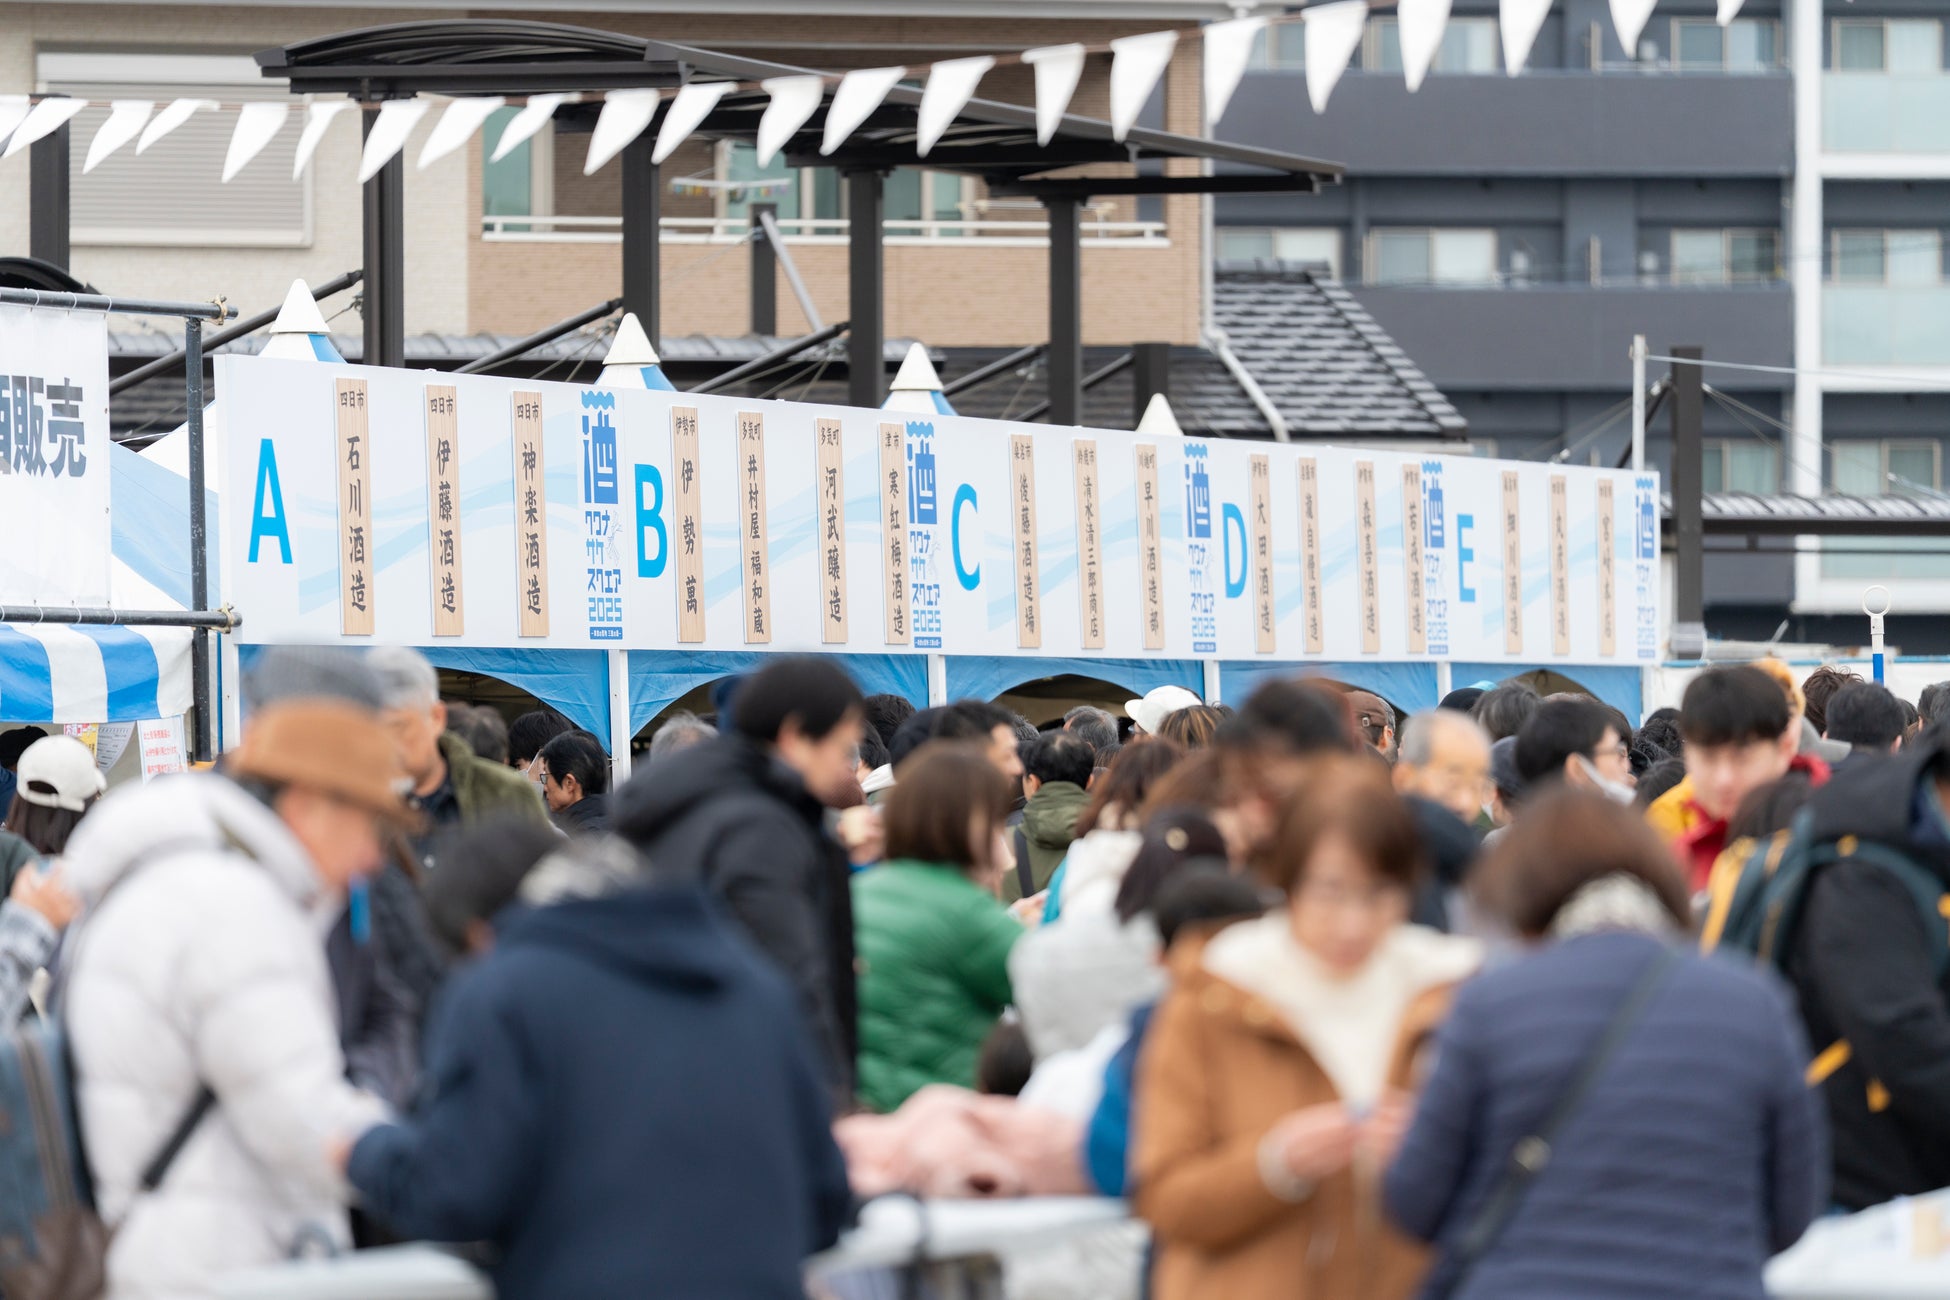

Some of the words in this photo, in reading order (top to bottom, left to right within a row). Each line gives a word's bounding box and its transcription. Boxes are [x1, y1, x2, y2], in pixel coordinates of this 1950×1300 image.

[340, 389, 364, 409] 四日市
[430, 396, 453, 415] 四日市
[517, 402, 539, 422] 四日市
[676, 416, 695, 435] 伊勢市
[743, 421, 760, 440] 多気町
[822, 427, 839, 446] 多気町
[582, 391, 618, 504] 酒
[886, 432, 899, 447] 津市
[1014, 441, 1031, 461] 桑名市
[248, 439, 293, 564] A
[347, 436, 366, 612] 石川酒造
[437, 438, 455, 613] 伊藤酒造
[522, 442, 541, 615] 神楽酒造
[635, 464, 667, 578] B
[682, 458, 697, 614] 伊勢萬
[826, 467, 841, 622] 河武醸造
[952, 484, 980, 591] C
[586, 539, 604, 564] サケ
[889, 469, 903, 635] 寒紅梅酒造
[1221, 502, 1248, 599] D
[1456, 513, 1476, 603] E
[911, 556, 925, 579] サケ
[1257, 494, 1271, 634] 大田酒造
[588, 569, 621, 593] スクエア
[912, 583, 940, 606] スクエア
[589, 597, 622, 622] 2025
[913, 610, 941, 632] 2025
[1191, 616, 1216, 638] 2025
